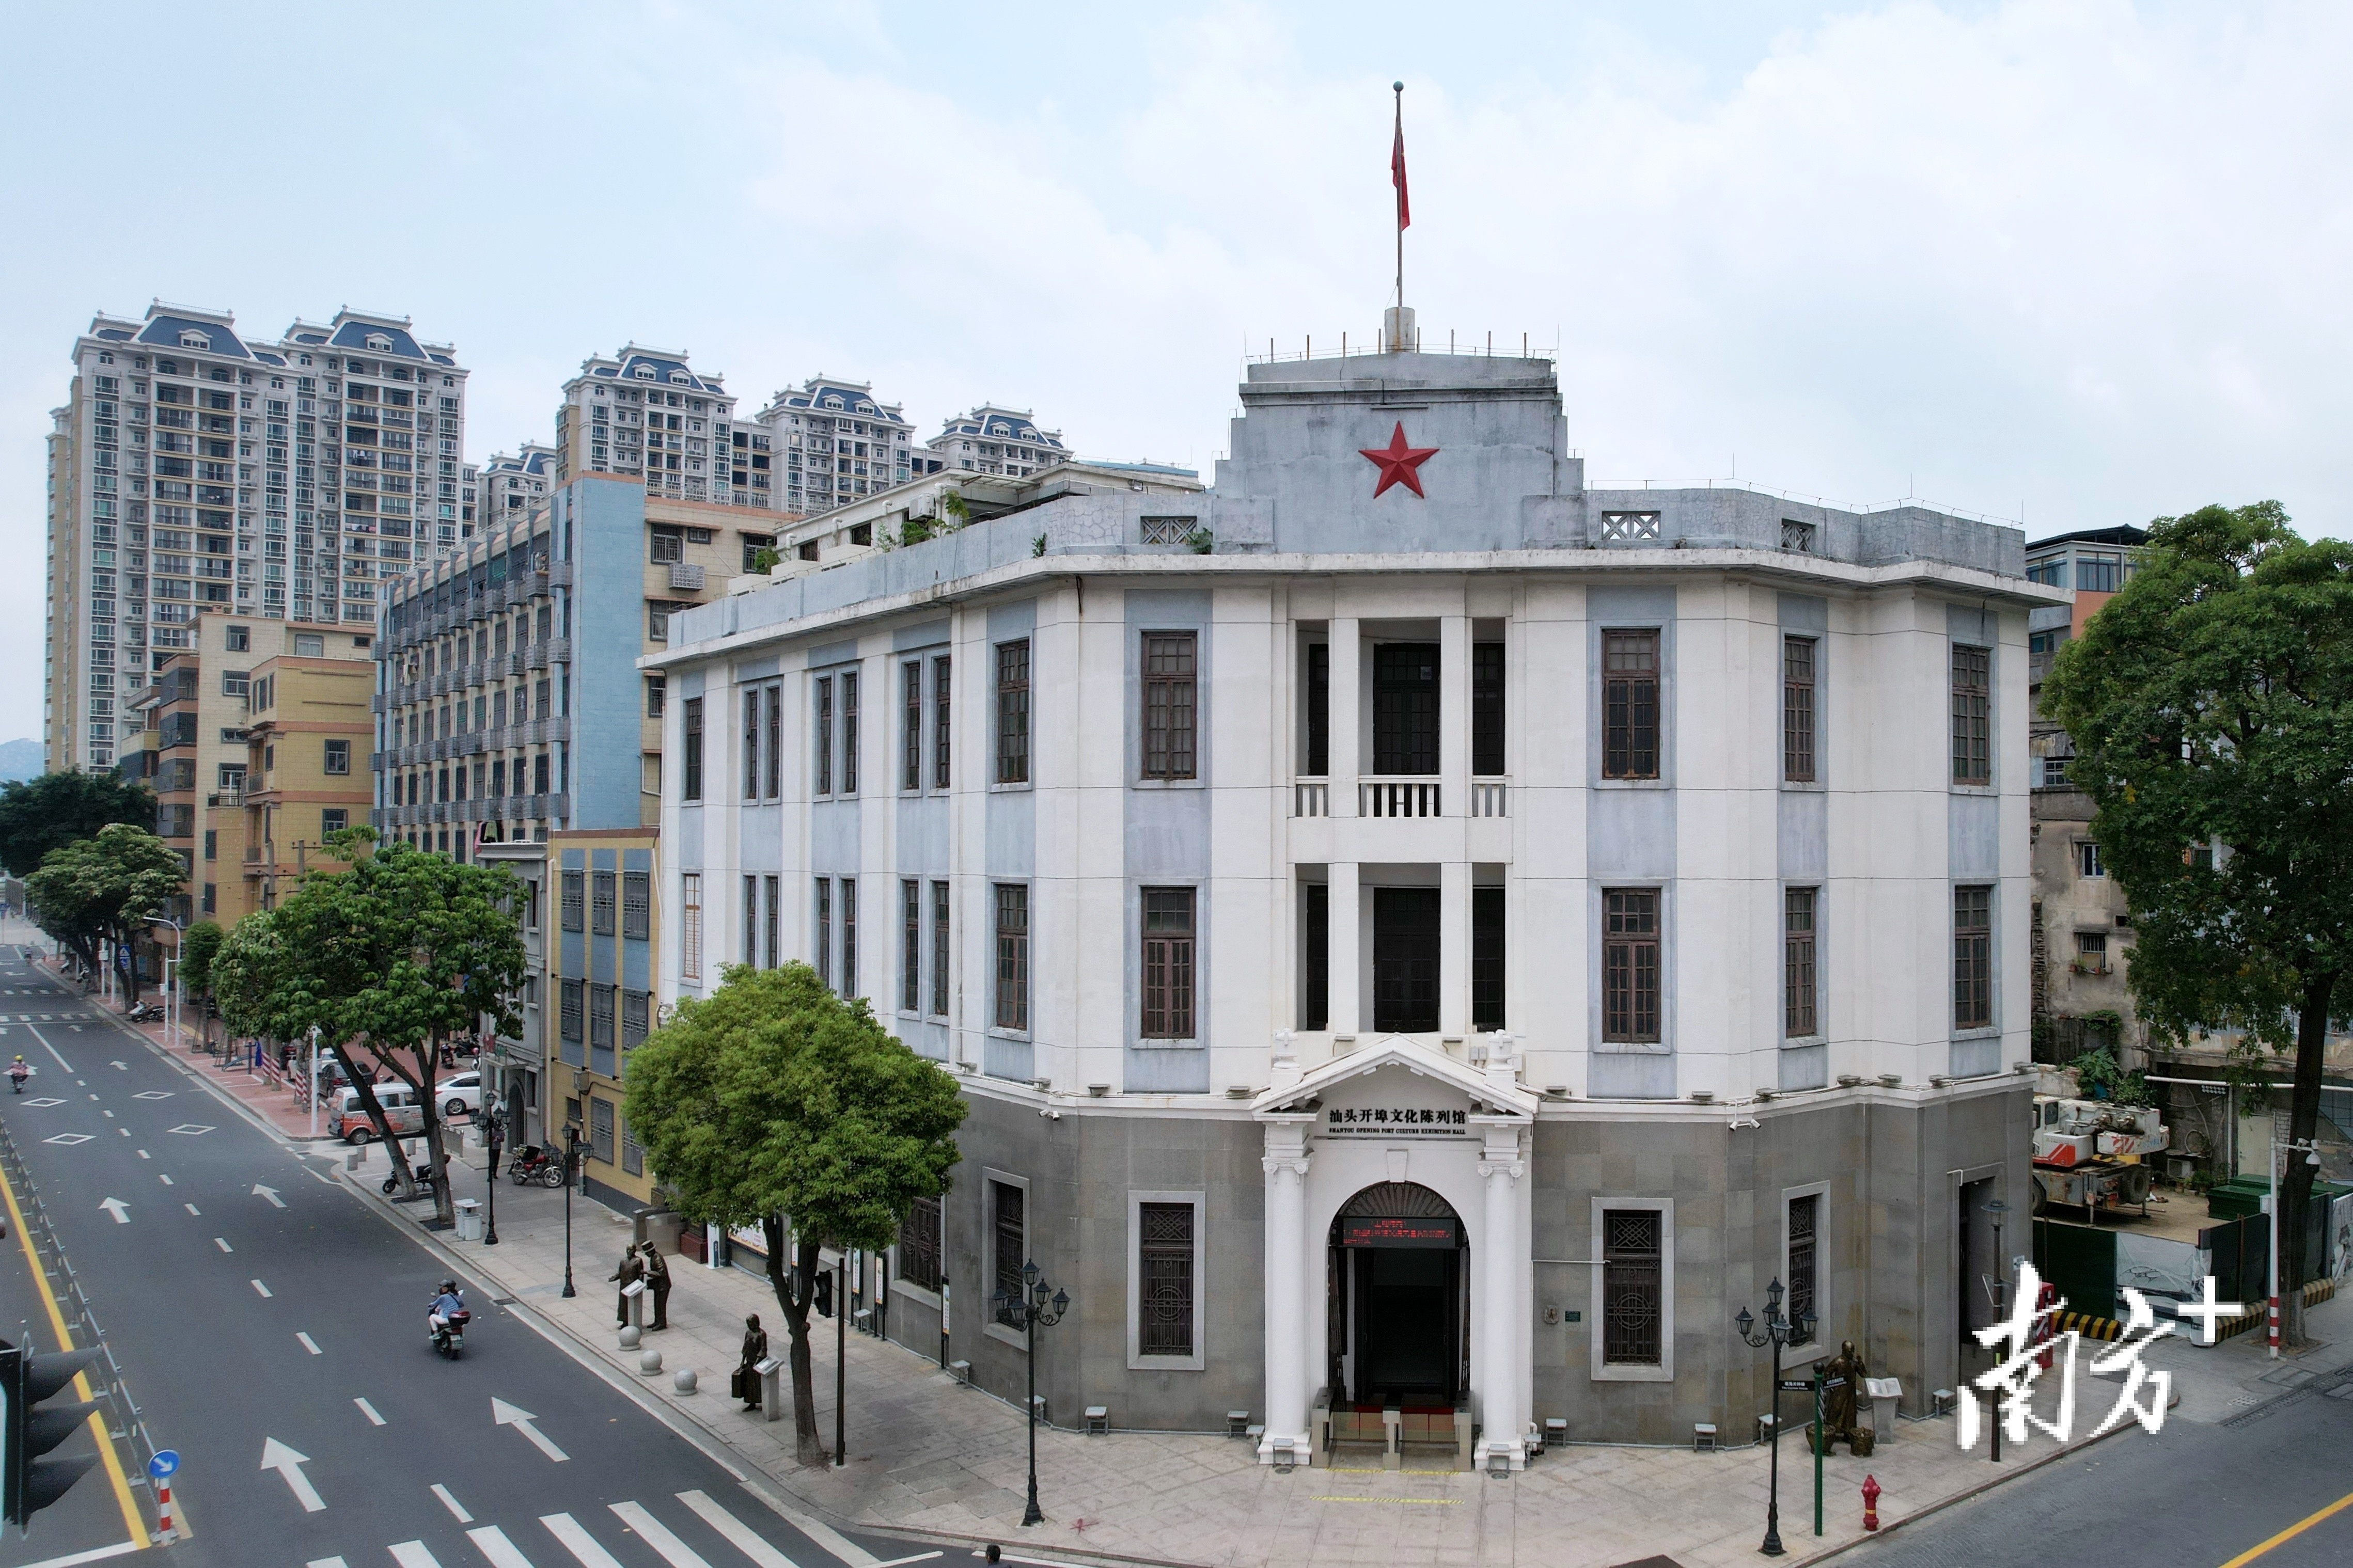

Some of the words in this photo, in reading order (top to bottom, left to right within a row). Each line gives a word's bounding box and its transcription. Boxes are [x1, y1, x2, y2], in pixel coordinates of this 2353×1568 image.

[1329, 1108, 1466, 1124] 汕头开埠文化陈列馆
